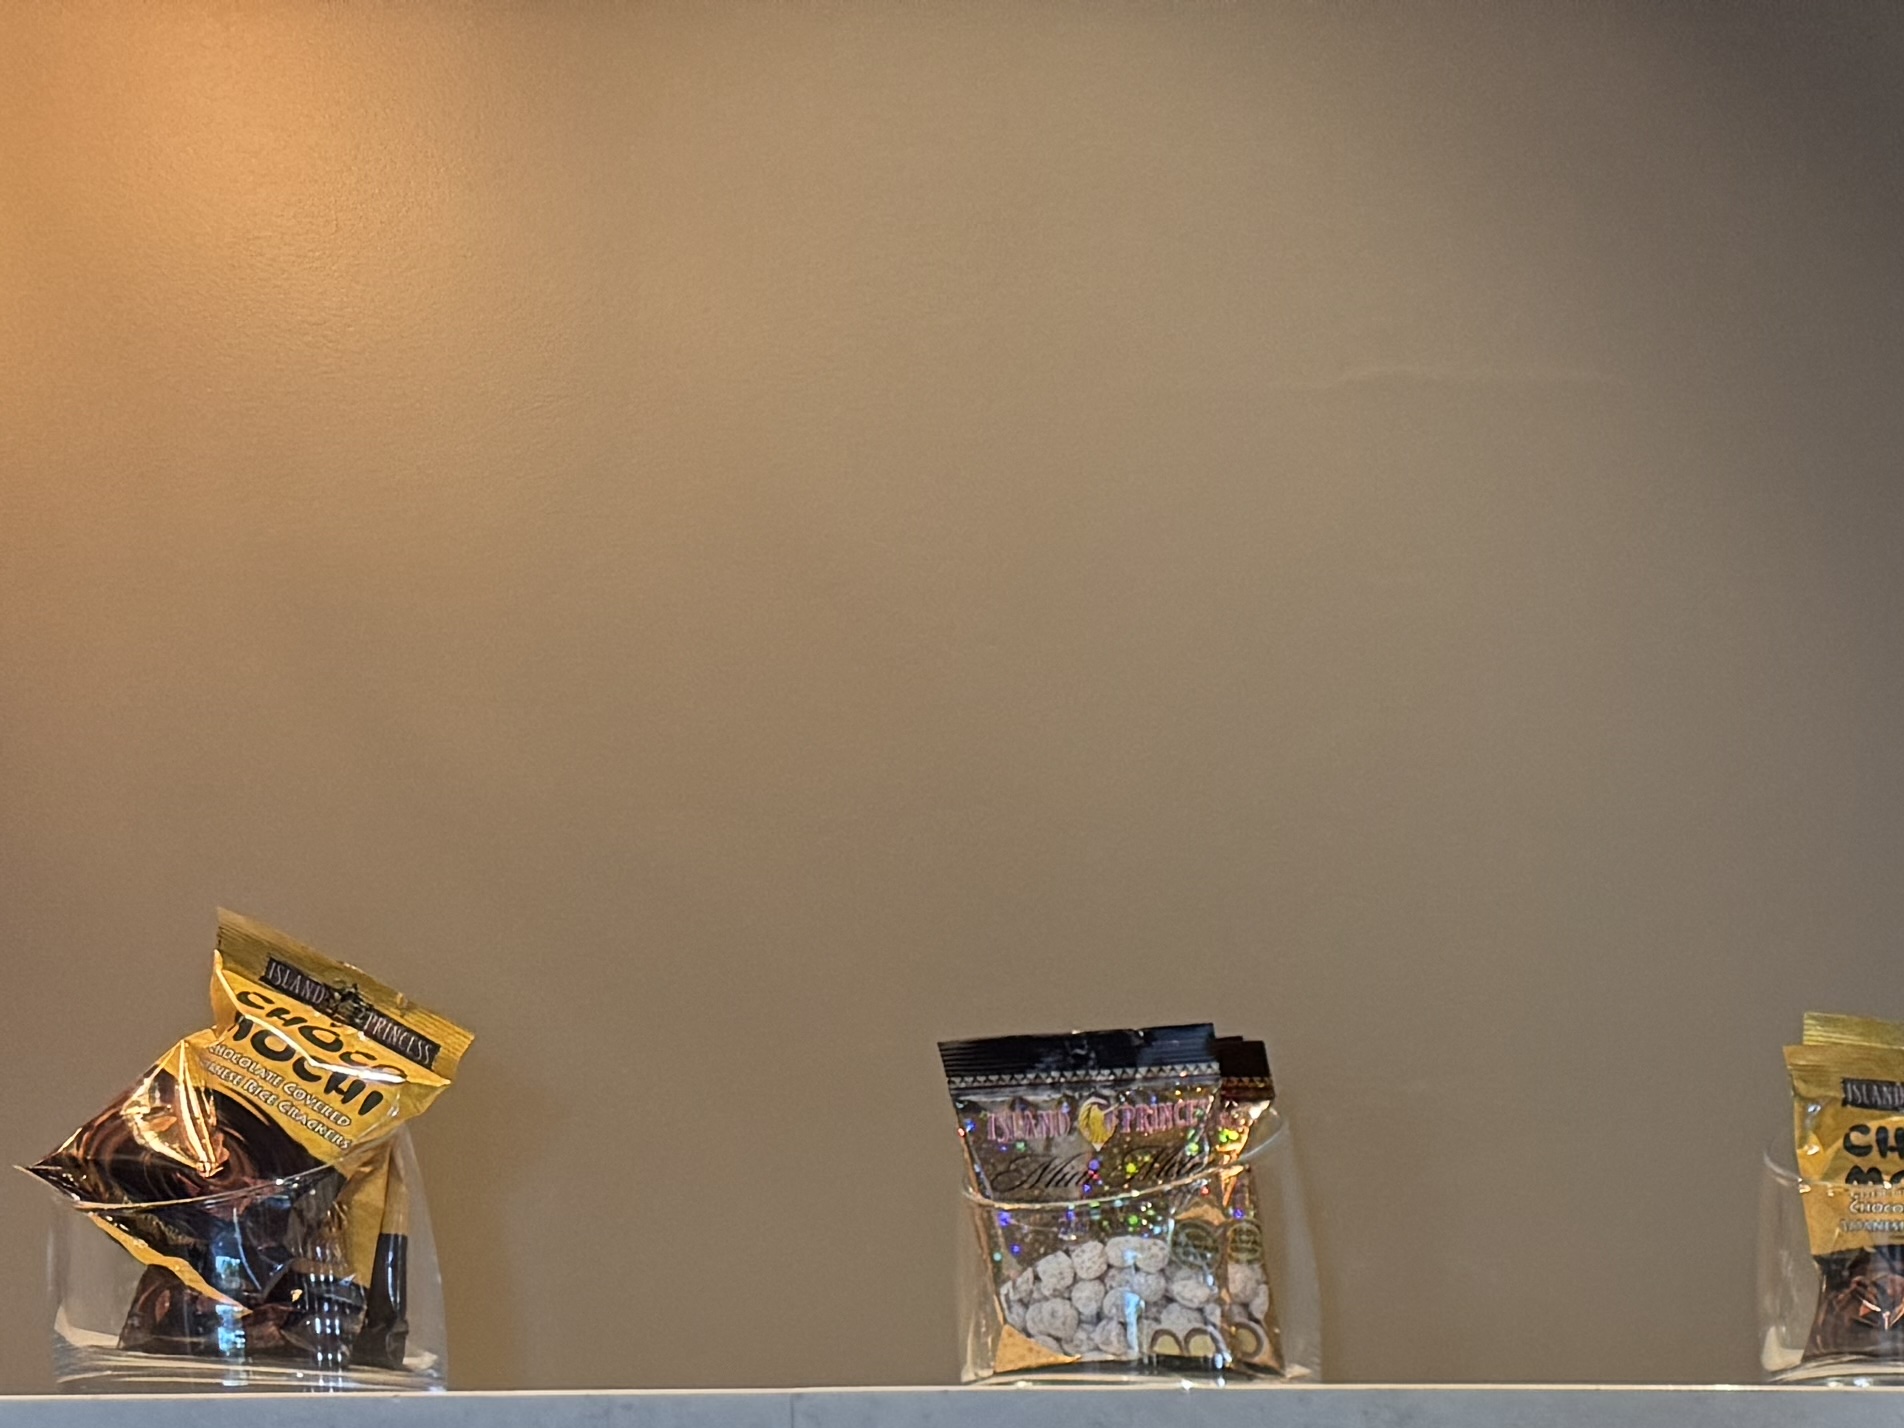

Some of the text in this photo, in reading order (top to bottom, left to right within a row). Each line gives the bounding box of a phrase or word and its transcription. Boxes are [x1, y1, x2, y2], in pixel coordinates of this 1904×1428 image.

[267, 961, 432, 1065] ISLAND PRINCESS
[244, 1080, 352, 1149] RICE CRACKERS
[283, 1082, 351, 1127] COVERED
